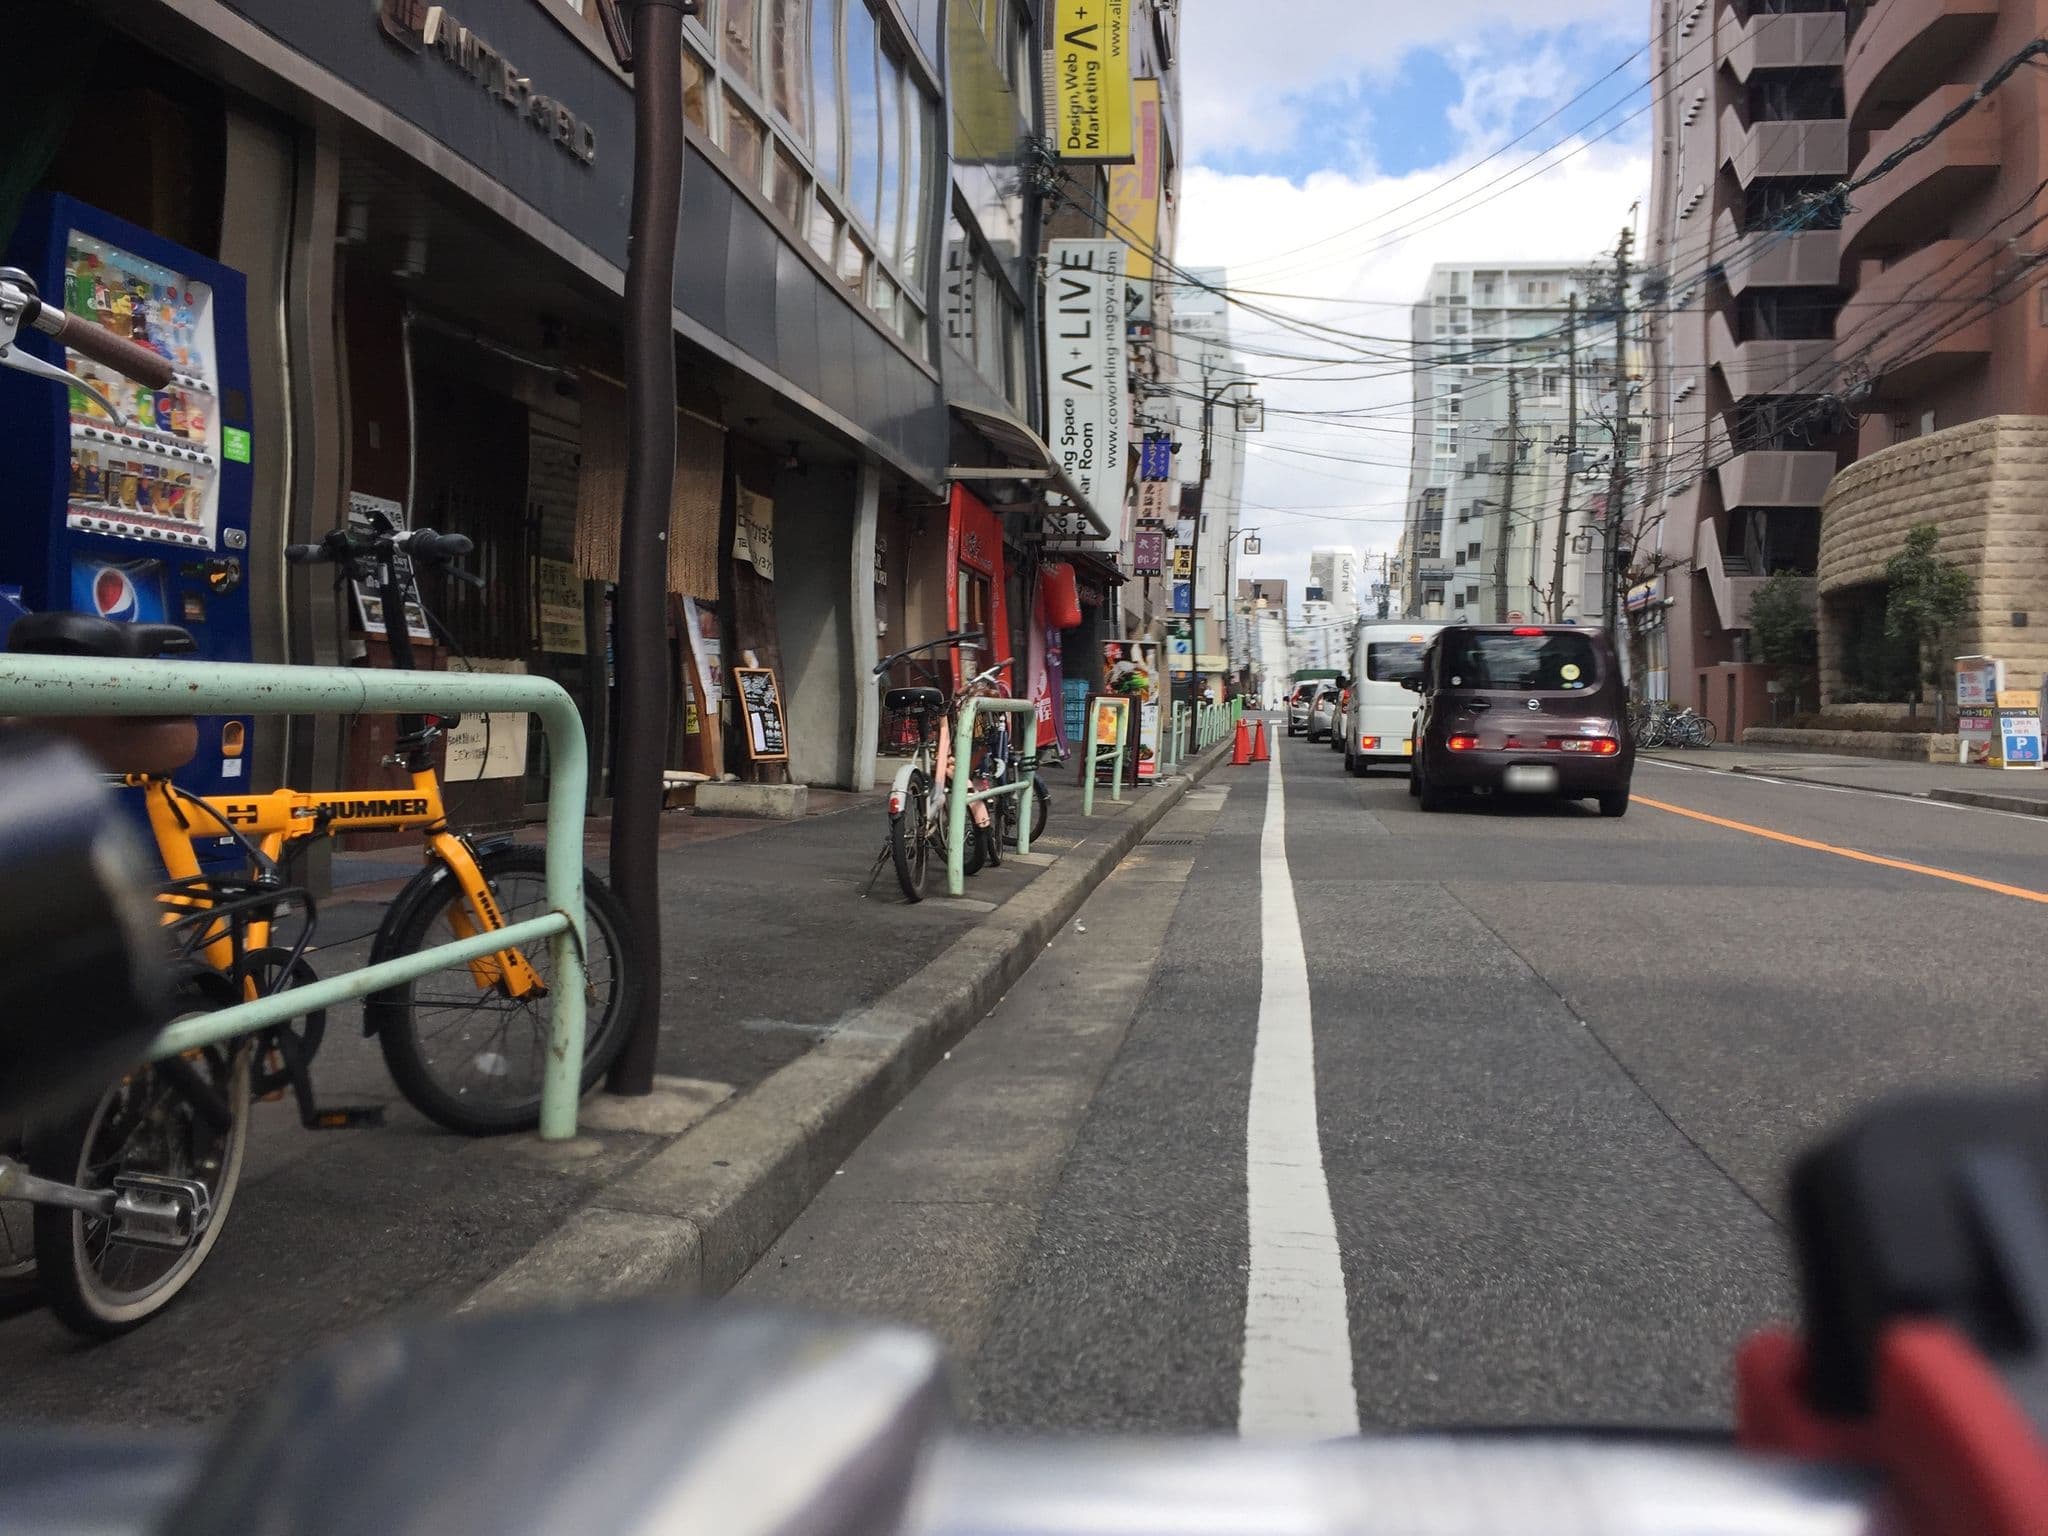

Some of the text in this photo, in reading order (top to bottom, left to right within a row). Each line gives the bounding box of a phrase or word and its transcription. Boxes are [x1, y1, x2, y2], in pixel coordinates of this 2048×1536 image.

[1083, 60, 1101, 149] Marketing
[1104, 251, 1119, 468] www.coworking-nagoya.com
[1060, 398, 1078, 447] Space
[1079, 422, 1093, 470] Room
[1151, 536, 1161, 565] スナック
[2016, 737, 2028, 750] P
[320, 799, 428, 819] HUMMER
